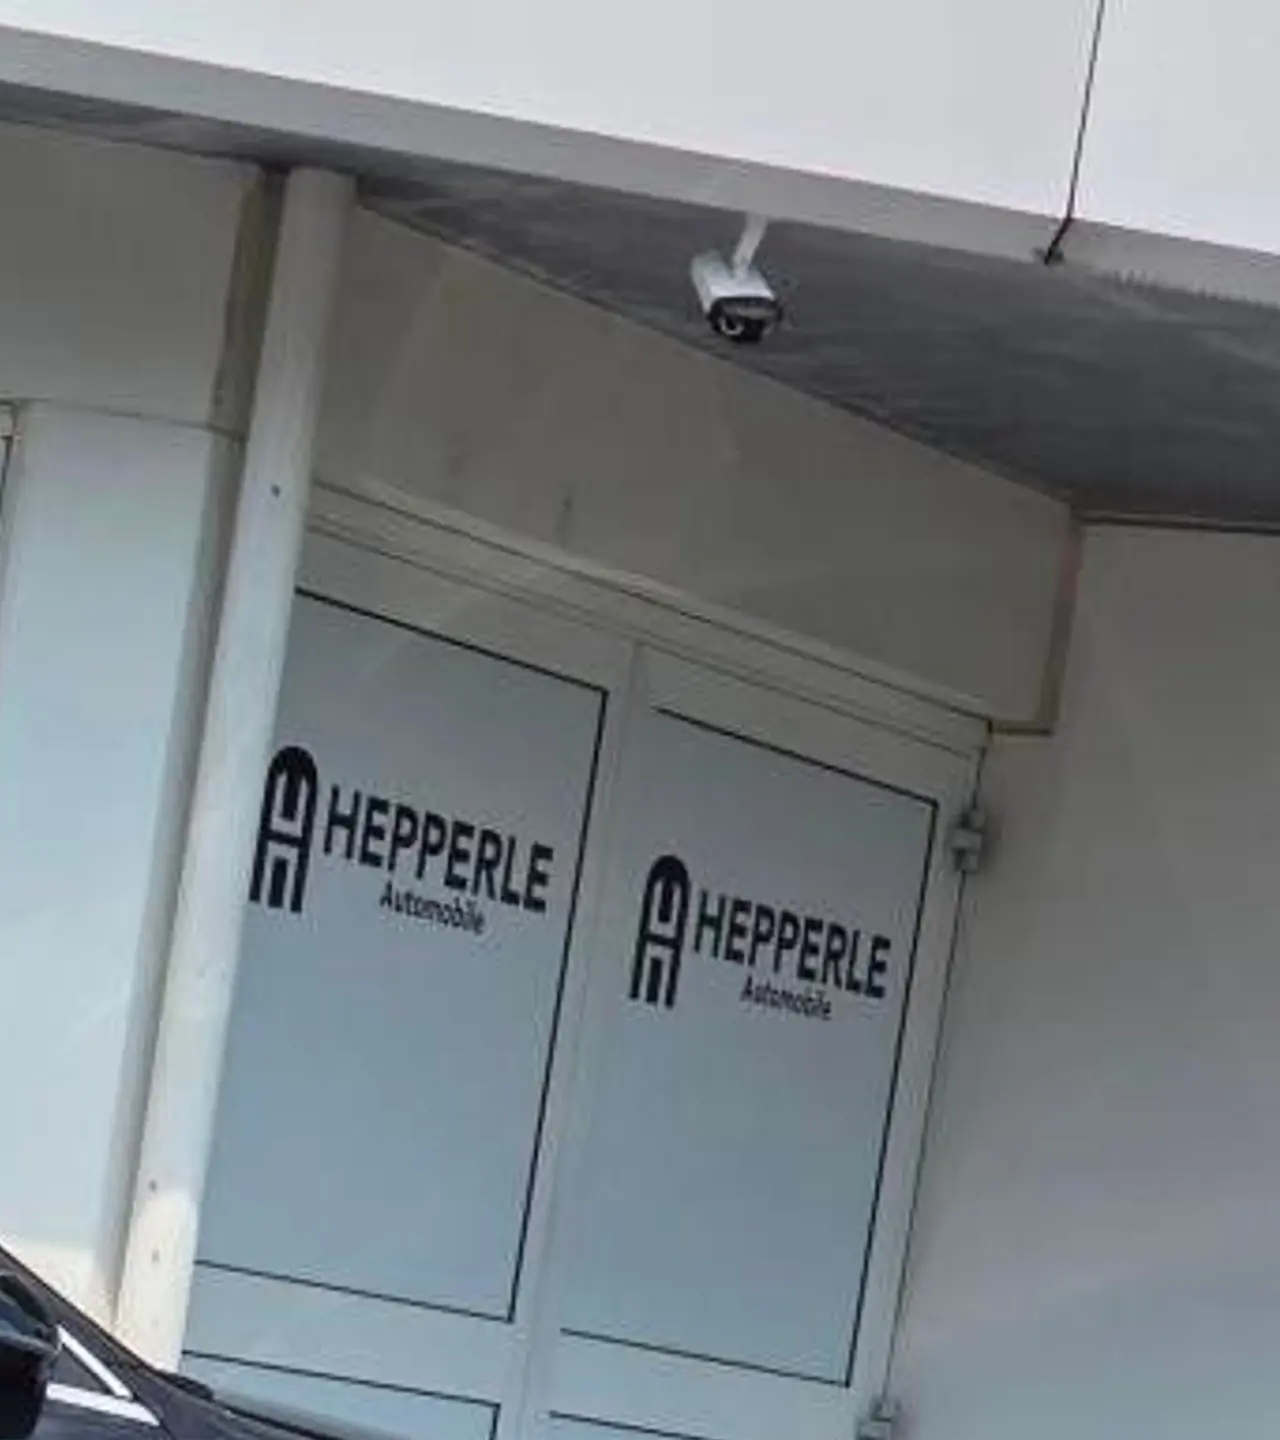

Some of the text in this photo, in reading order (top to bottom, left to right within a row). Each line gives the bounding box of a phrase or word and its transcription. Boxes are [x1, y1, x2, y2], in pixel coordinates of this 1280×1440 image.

[323, 783, 555, 915] HEPPERLE
[379, 879, 486, 936] Automobile
[693, 888, 891, 999] HEPPERLE
[739, 973, 833, 1022] Automobile
